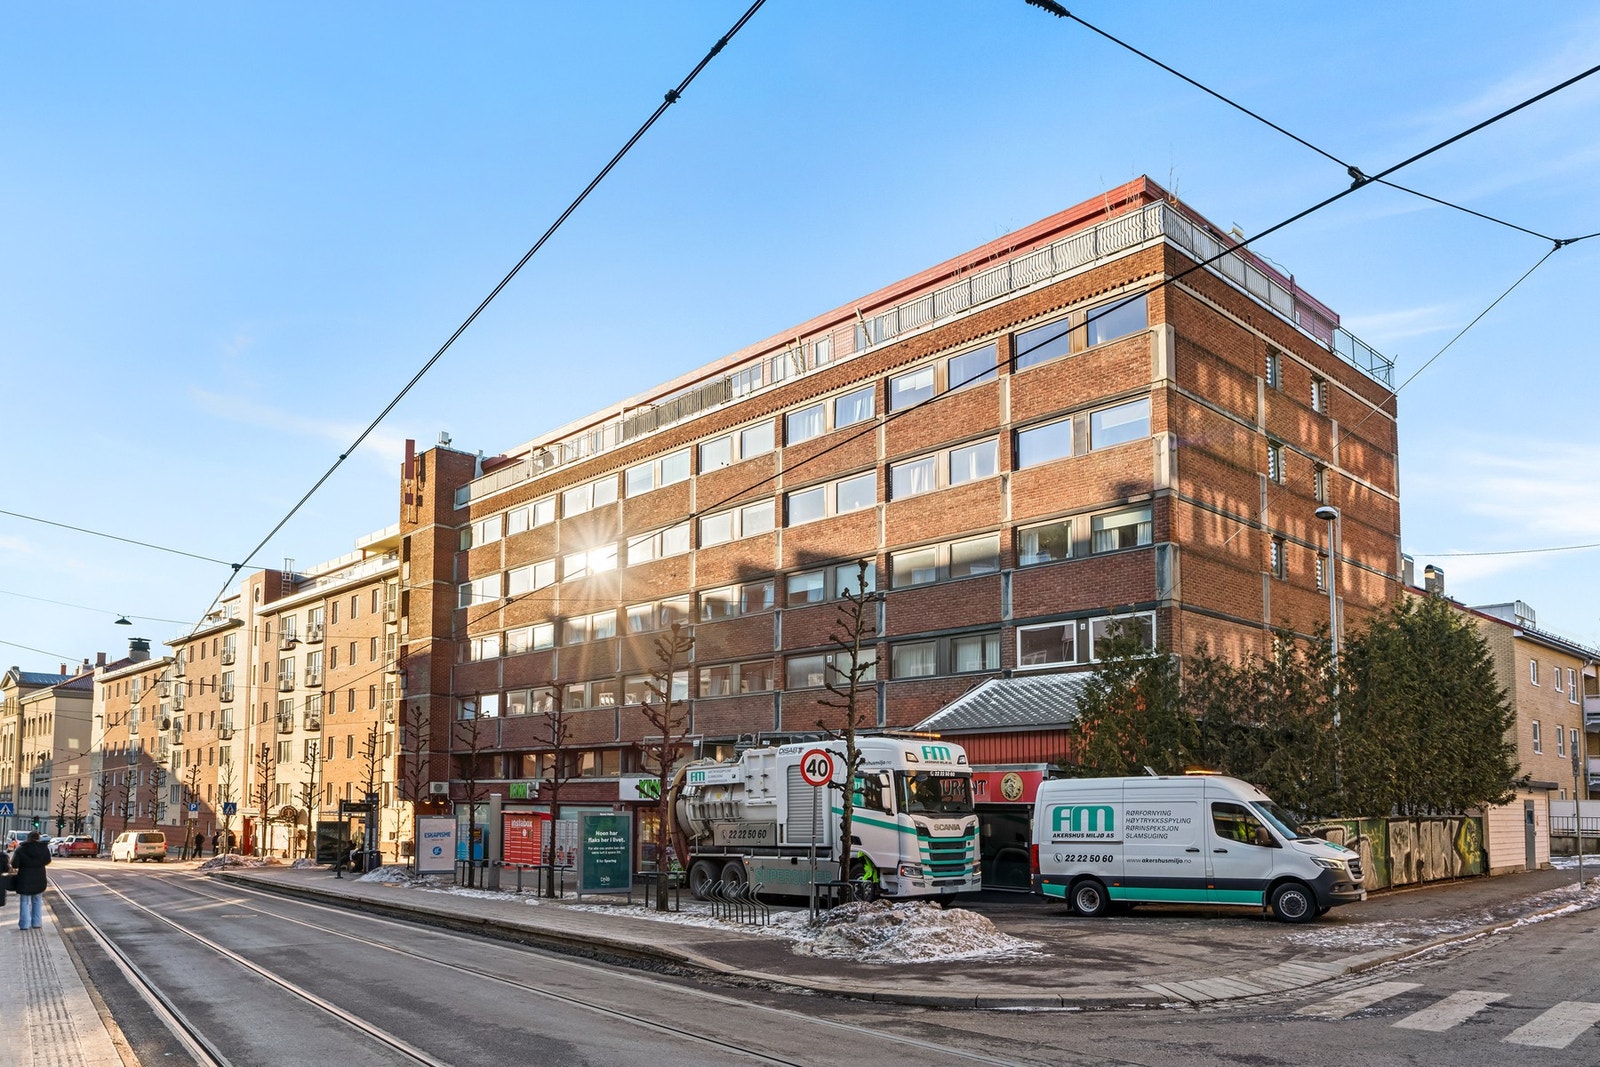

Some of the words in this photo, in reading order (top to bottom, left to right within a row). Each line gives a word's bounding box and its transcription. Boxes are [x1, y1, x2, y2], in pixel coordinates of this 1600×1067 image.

[806, 759, 828, 777] 40
[639, 779, 661, 798] KIW
[728, 830, 736, 839] 22
[737, 830, 746, 838] 22
[748, 830, 756, 838] 50
[757, 829, 767, 838] 60
[933, 823, 961, 831] SCANIA
[1089, 855, 1100, 863] 50
[1102, 855, 1114, 863] 60
[755, 867, 833, 885] SUPERSUER
